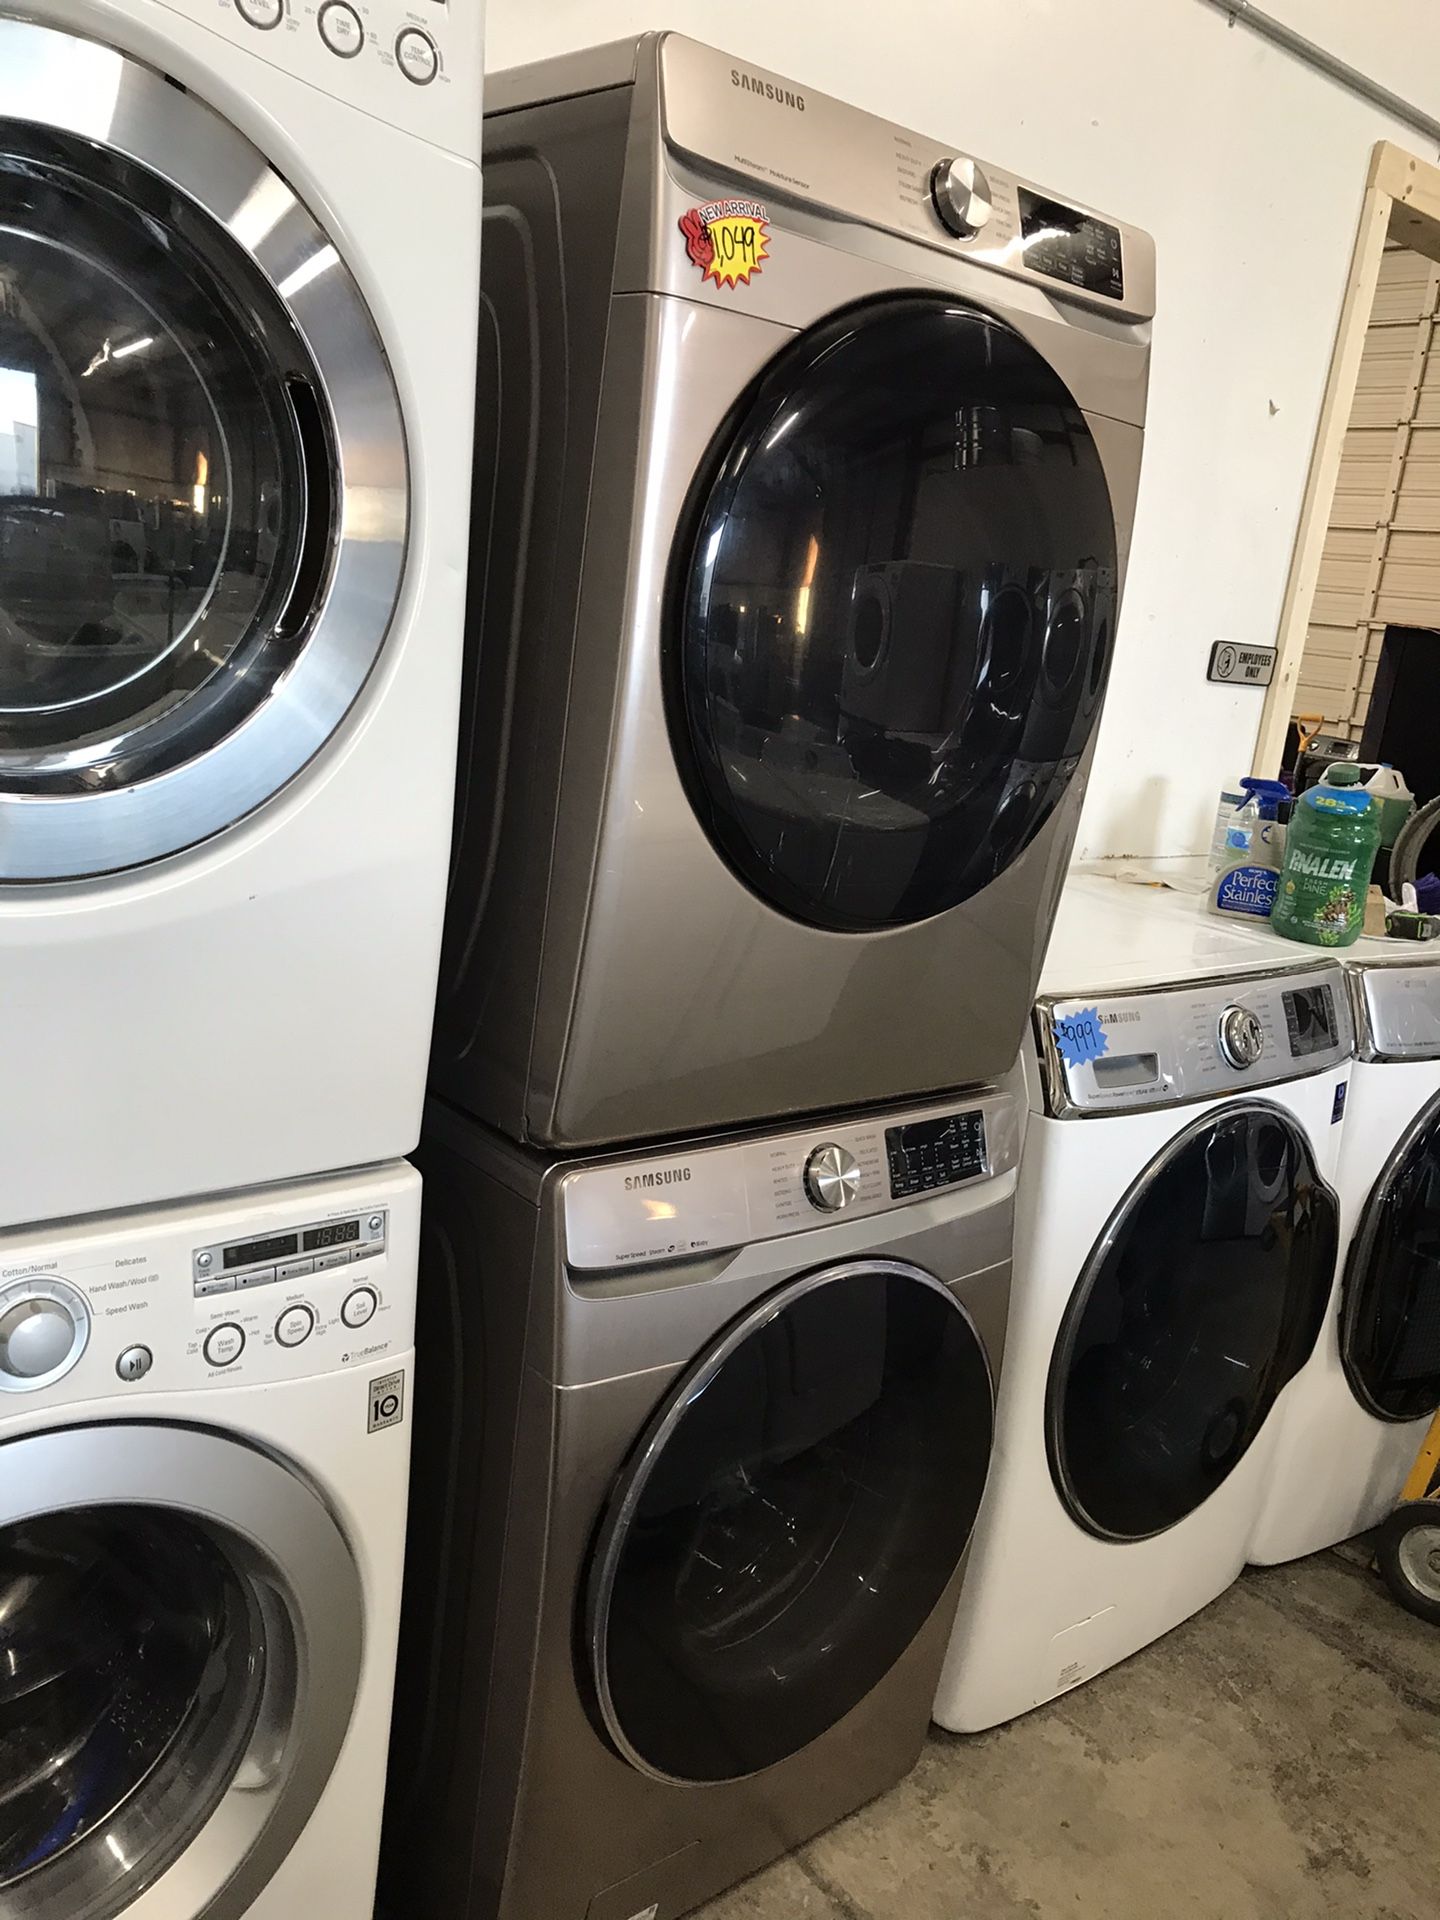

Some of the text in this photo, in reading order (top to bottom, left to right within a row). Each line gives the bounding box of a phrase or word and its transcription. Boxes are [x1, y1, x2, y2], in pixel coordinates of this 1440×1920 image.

[731, 69, 805, 112] SAMSUNG
[700, 201, 768, 223] NEW ARRIVAL
[700, 223, 755, 268] $1,049
[1239, 652, 1272, 667] EMPLOYEES
[1245, 666, 1261, 678] ONLY
[1232, 871, 1277, 892] Perfect
[1303, 883, 1328, 896] PINE
[1098, 1011, 1141, 1025] SAMSUNG
[1061, 1021, 1097, 1052] $999
[624, 1168, 692, 1191] SAMSUNG
[115, 1256, 147, 1268] Delicates
[2, 1261, 58, 1279] Cotton/Normal
[89, 1277, 147, 1294] Hand Wash/Wool
[105, 1301, 148, 1316] Speed Wash
[286, 1326, 305, 1336] Speed
[289, 1321, 302, 1329] Spin
[217, 1338, 235, 1348] Wash
[217, 1345, 234, 1354] Temp
[374, 1394, 399, 1422] 10
